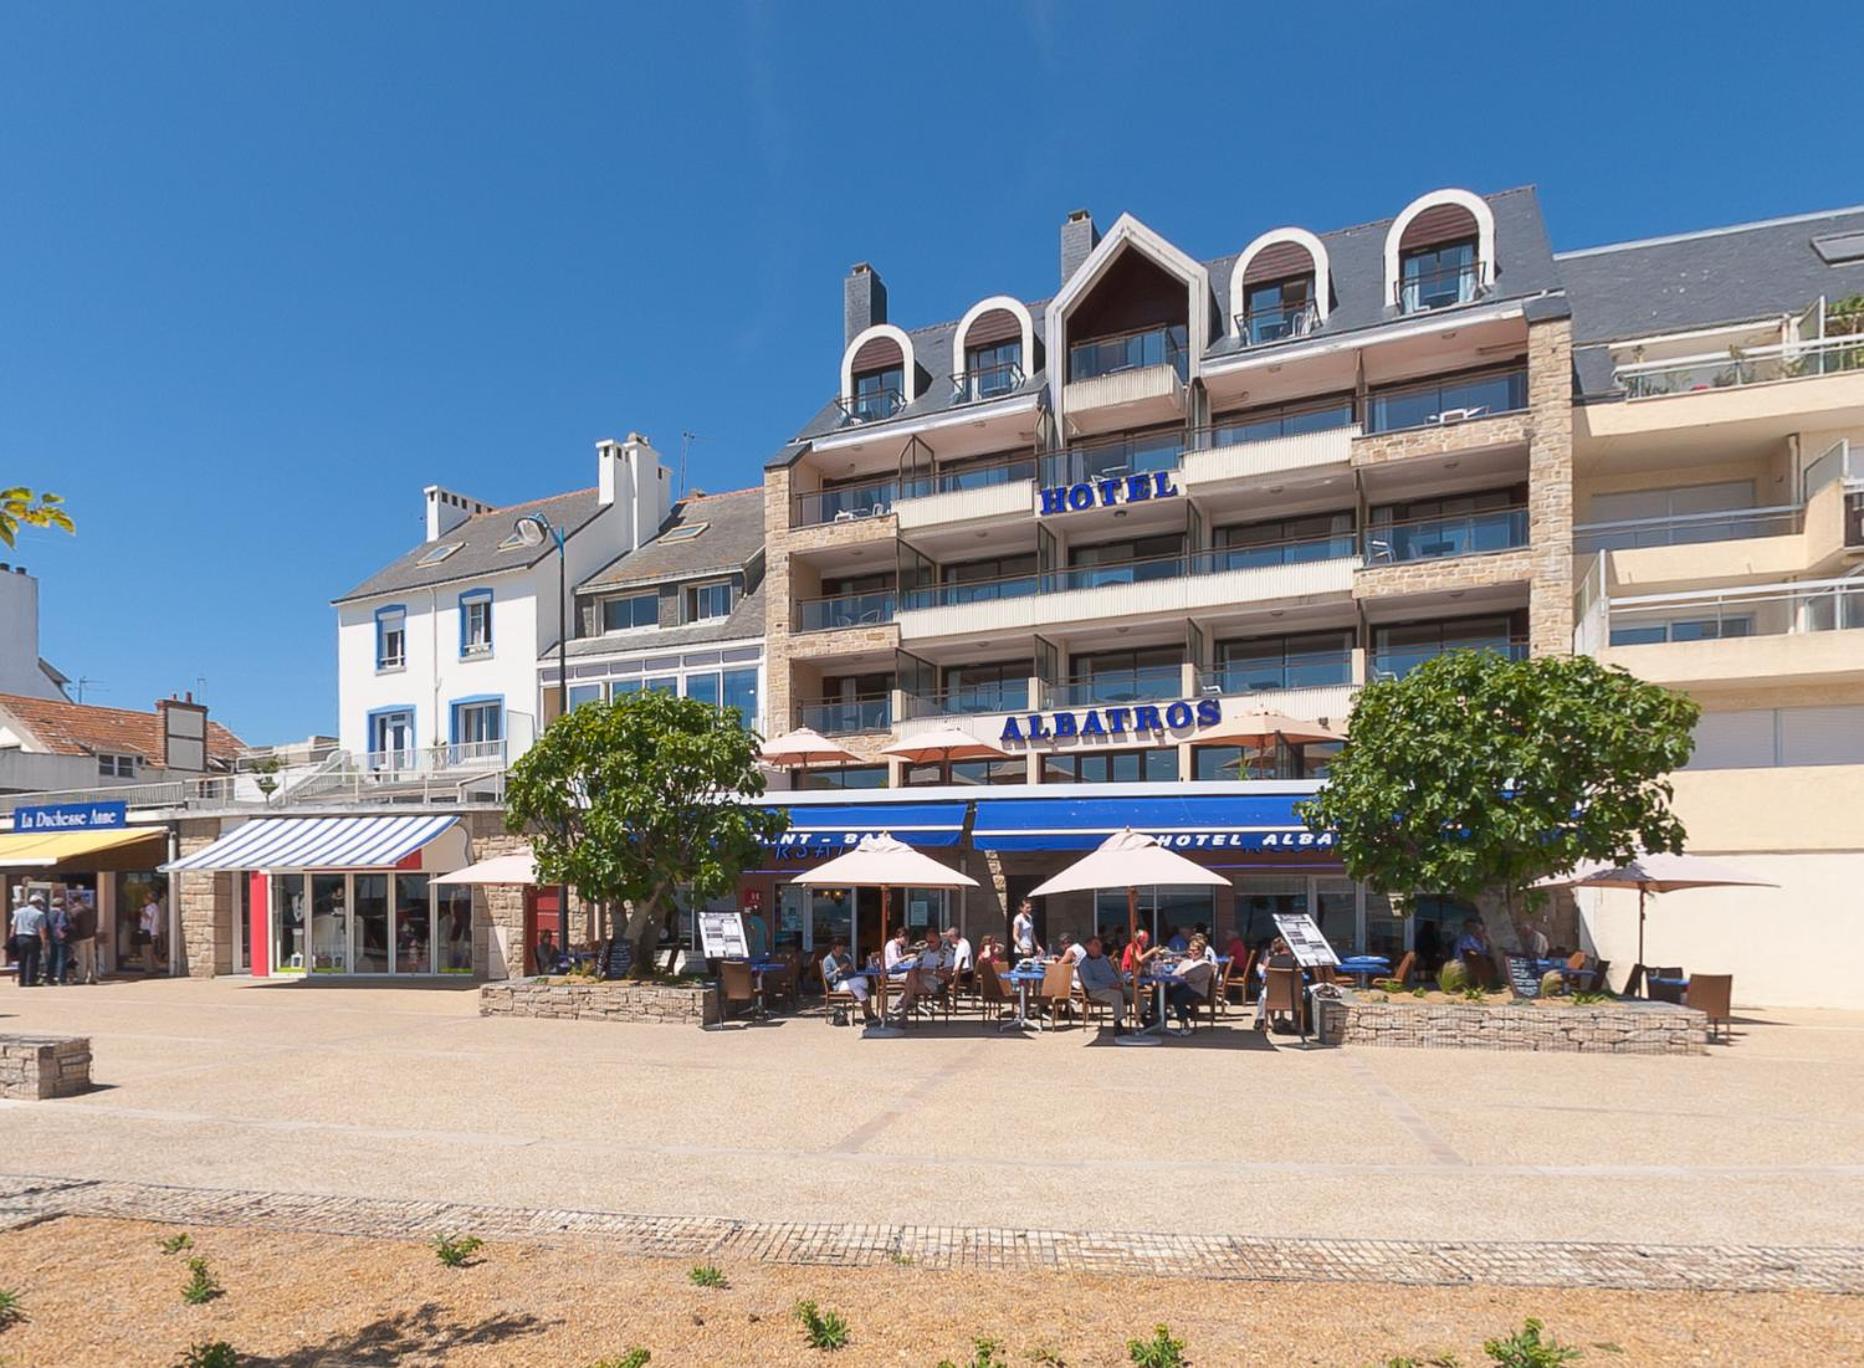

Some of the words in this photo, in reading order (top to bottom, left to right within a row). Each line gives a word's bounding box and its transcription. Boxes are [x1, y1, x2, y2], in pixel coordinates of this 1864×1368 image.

[1040, 471, 1178, 515] HOTEL
[1001, 699, 1222, 741] ALBATROS
[36, 809, 87, 827] Duchesse
[90, 808, 117, 825] Anne
[1156, 833, 1241, 847] HOTEL
